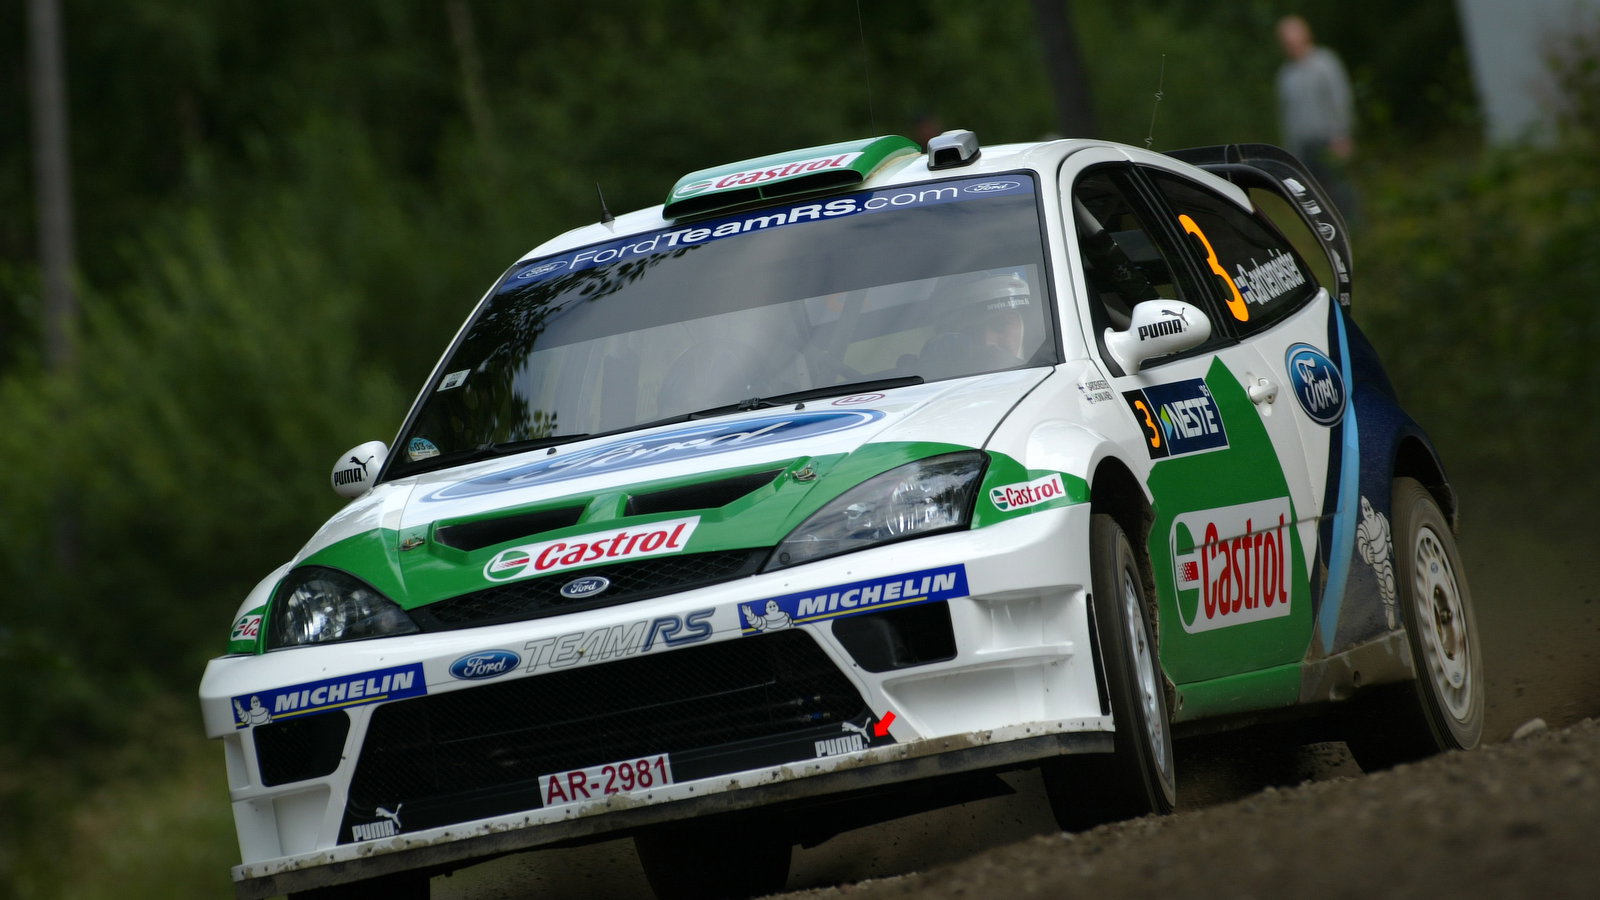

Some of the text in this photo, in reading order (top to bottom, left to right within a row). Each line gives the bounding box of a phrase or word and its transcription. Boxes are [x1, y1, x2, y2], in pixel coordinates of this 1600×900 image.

[715, 154, 849, 189] Castrol
[569, 187, 958, 270] FordTeamRS.com
[1178, 214, 1249, 322] 3
[1236, 248, 1306, 305] Gardemeister
[1138, 319, 1183, 341] PUMA
[1295, 357, 1339, 413] Ford
[1134, 400, 1161, 448] 3
[1167, 397, 1220, 440] NESTE
[509, 421, 793, 484] Ford
[334, 467, 363, 487] PUMA
[1005, 478, 1062, 507] Castrol
[534, 522, 687, 571] Castrol
[1201, 512, 1288, 620] Castrol
[570, 580, 598, 594] Ford
[796, 571, 957, 617] MICHELIN
[463, 653, 506, 678] Ford
[274, 671, 416, 714] MICHELIN
[814, 734, 864, 758] PUMA
[546, 755, 669, 805] AR-2981
[352, 819, 395, 842] PUMA
